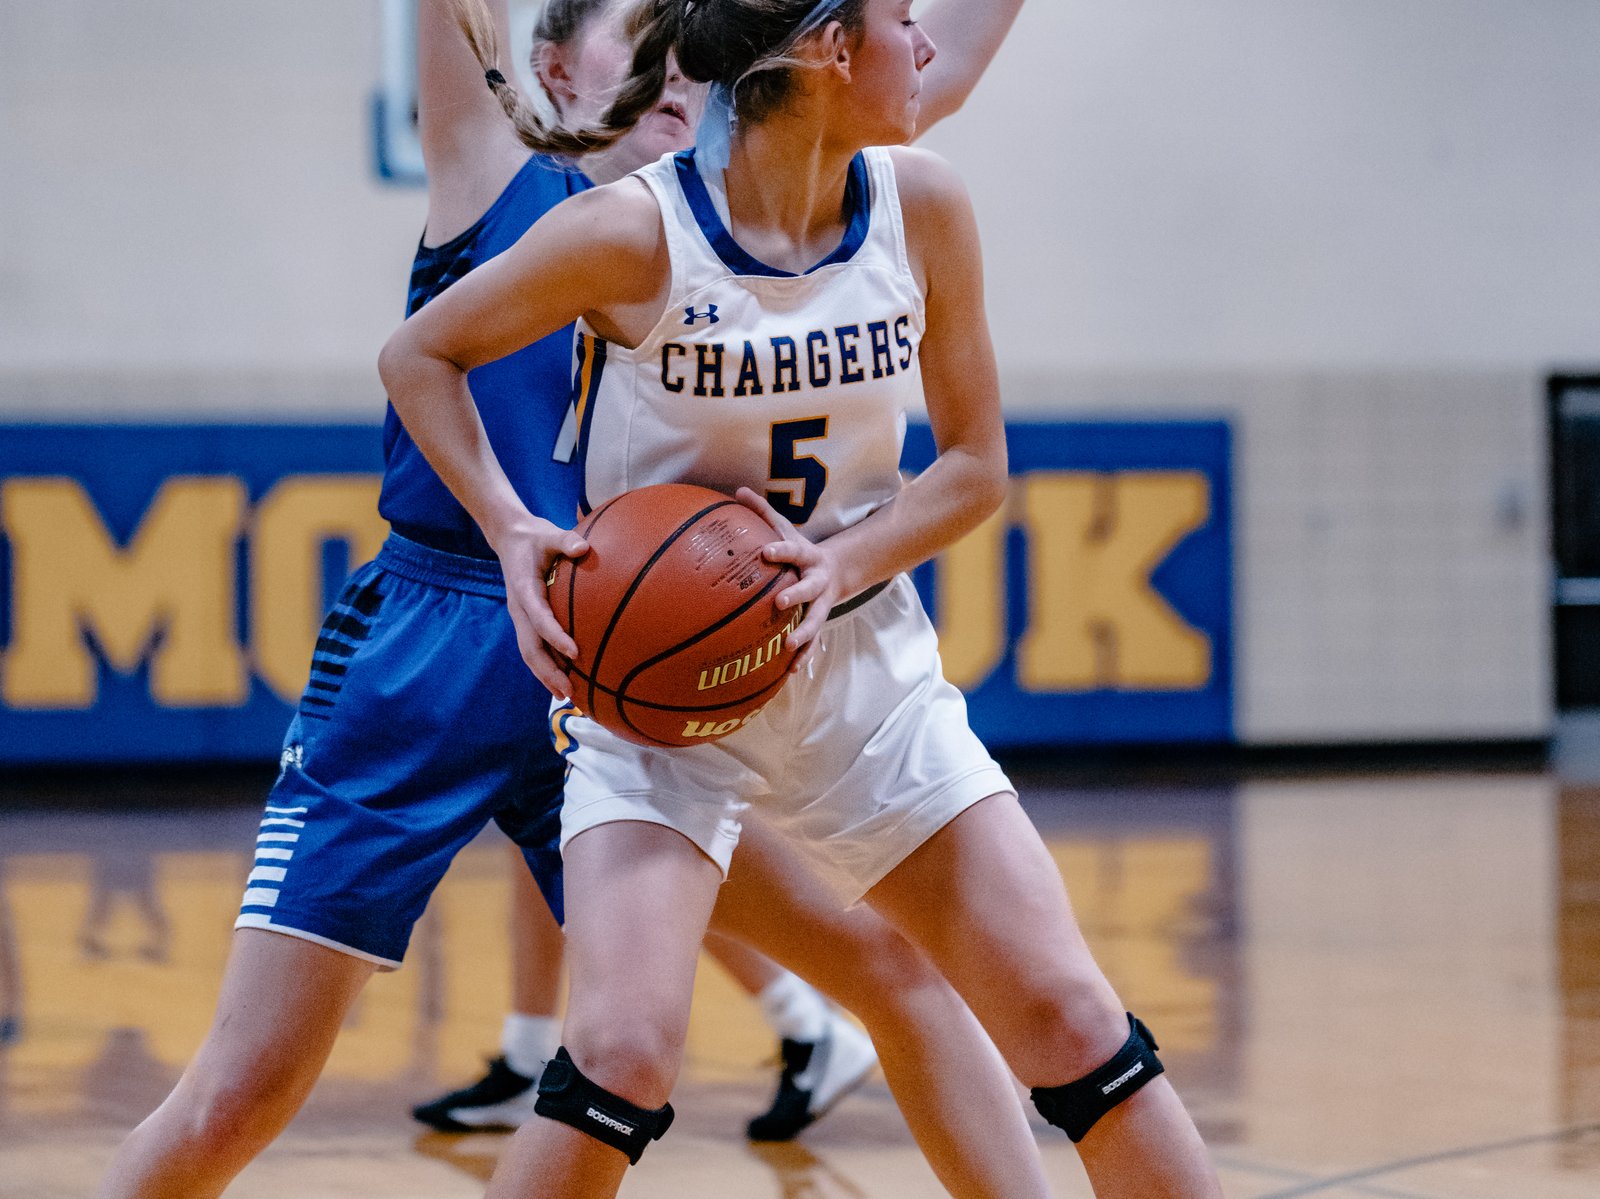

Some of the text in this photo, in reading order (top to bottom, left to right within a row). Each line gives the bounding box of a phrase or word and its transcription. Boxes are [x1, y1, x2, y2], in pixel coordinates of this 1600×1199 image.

[661, 315, 912, 397] CHARGERS
[765, 415, 829, 526] 5
[586, 1107, 634, 1136] BODYPROX
